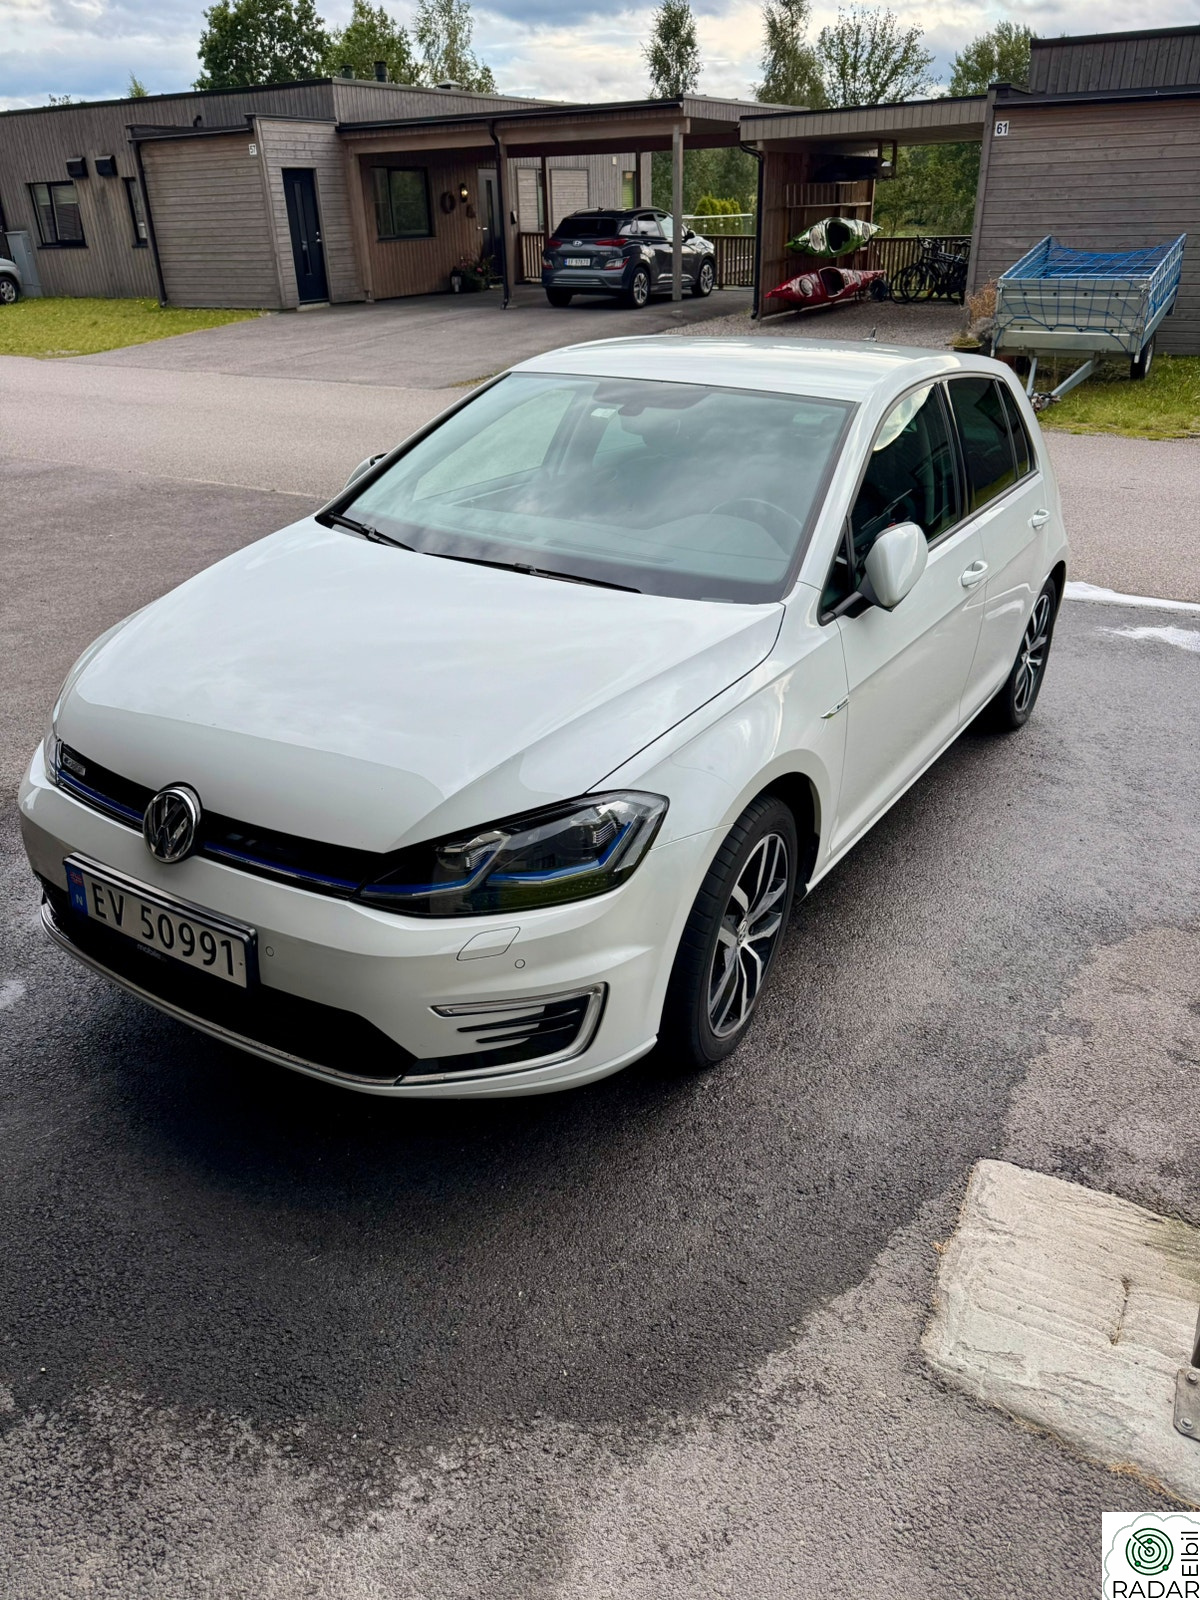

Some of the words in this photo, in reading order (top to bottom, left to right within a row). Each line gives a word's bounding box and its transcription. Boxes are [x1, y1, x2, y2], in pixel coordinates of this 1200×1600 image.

[996, 122, 1008, 135] 61
[91, 882, 125, 927] EV
[140, 904, 235, 977] 50991
